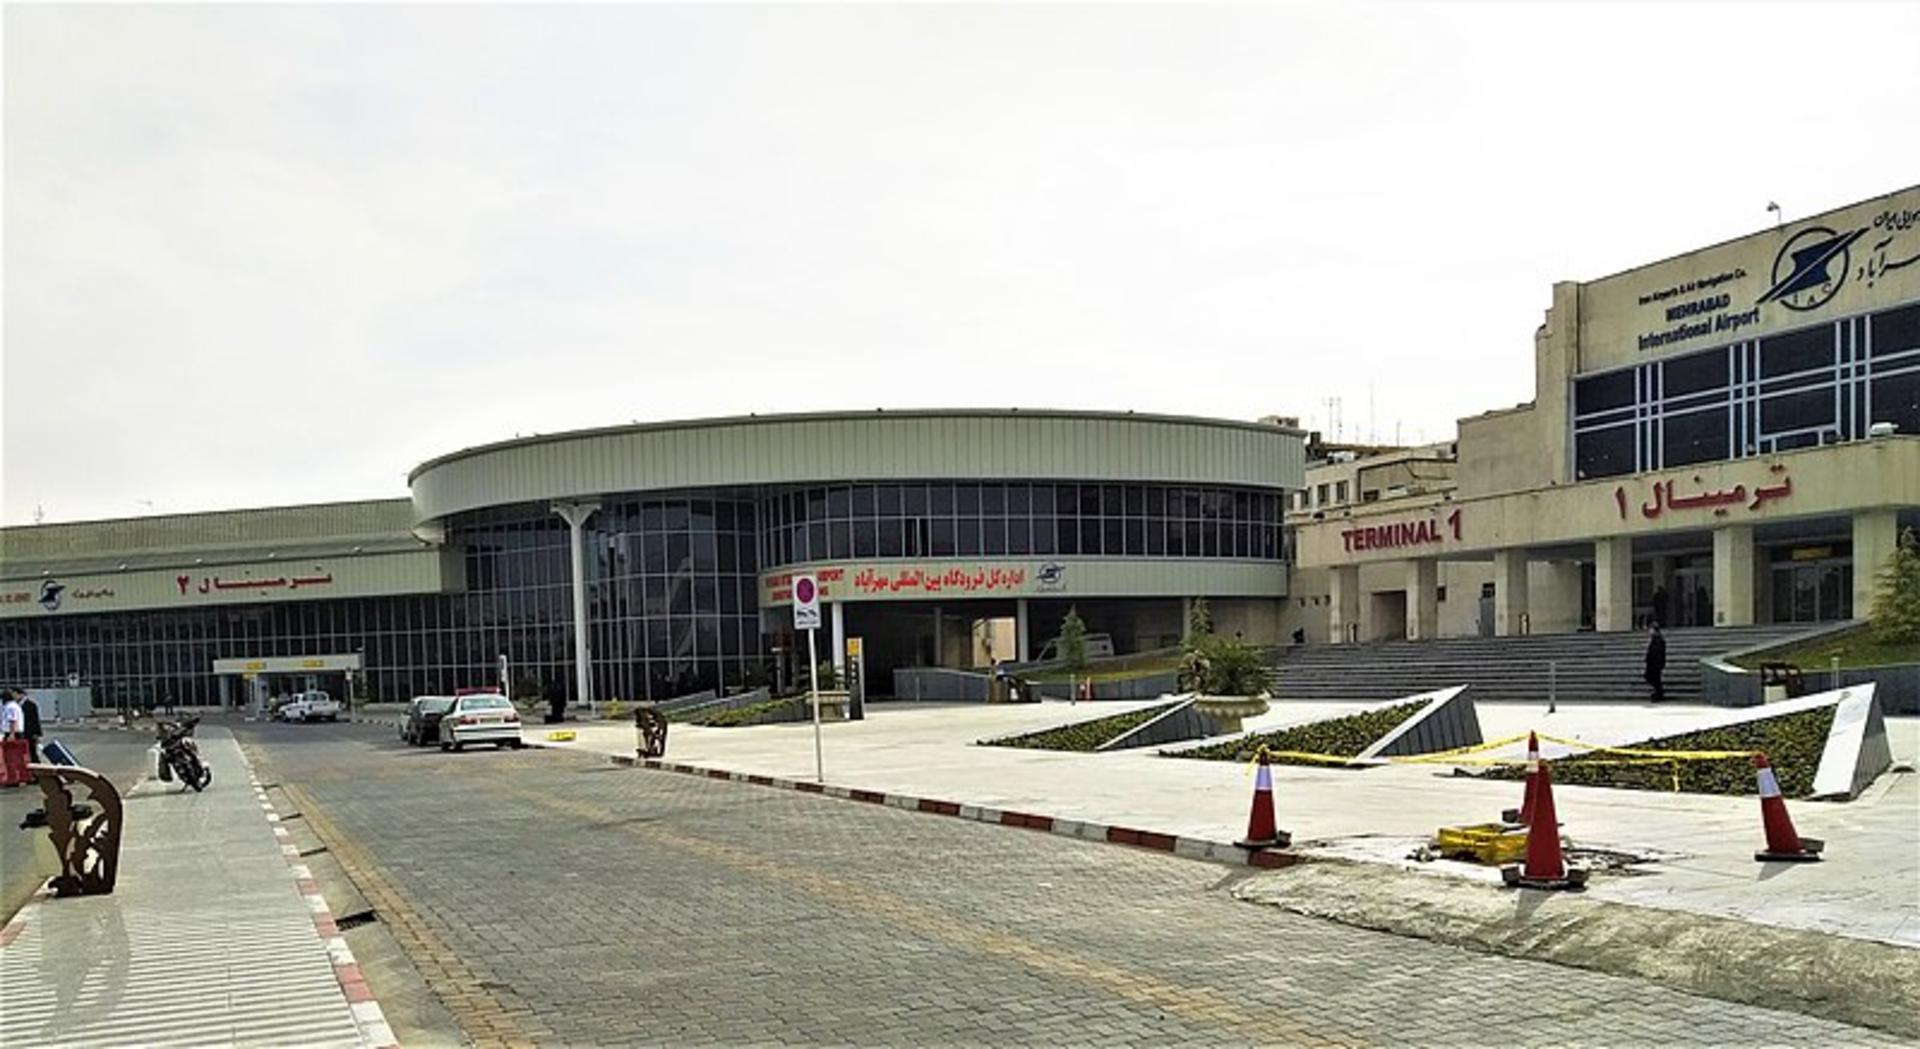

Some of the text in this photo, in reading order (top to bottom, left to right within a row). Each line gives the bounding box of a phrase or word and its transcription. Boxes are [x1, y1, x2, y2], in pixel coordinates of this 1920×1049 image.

[1665, 293, 1731, 322] MEHRABAD
[1638, 306, 1760, 352] International Airport
[1641, 463, 1792, 520] ترمینال
[1341, 508, 1463, 553] TERMINAL 1
[198, 564, 333, 597] ترمینال
[853, 566, 889, 594] مهرآباد
[943, 565, 984, 592] فرودگاه
